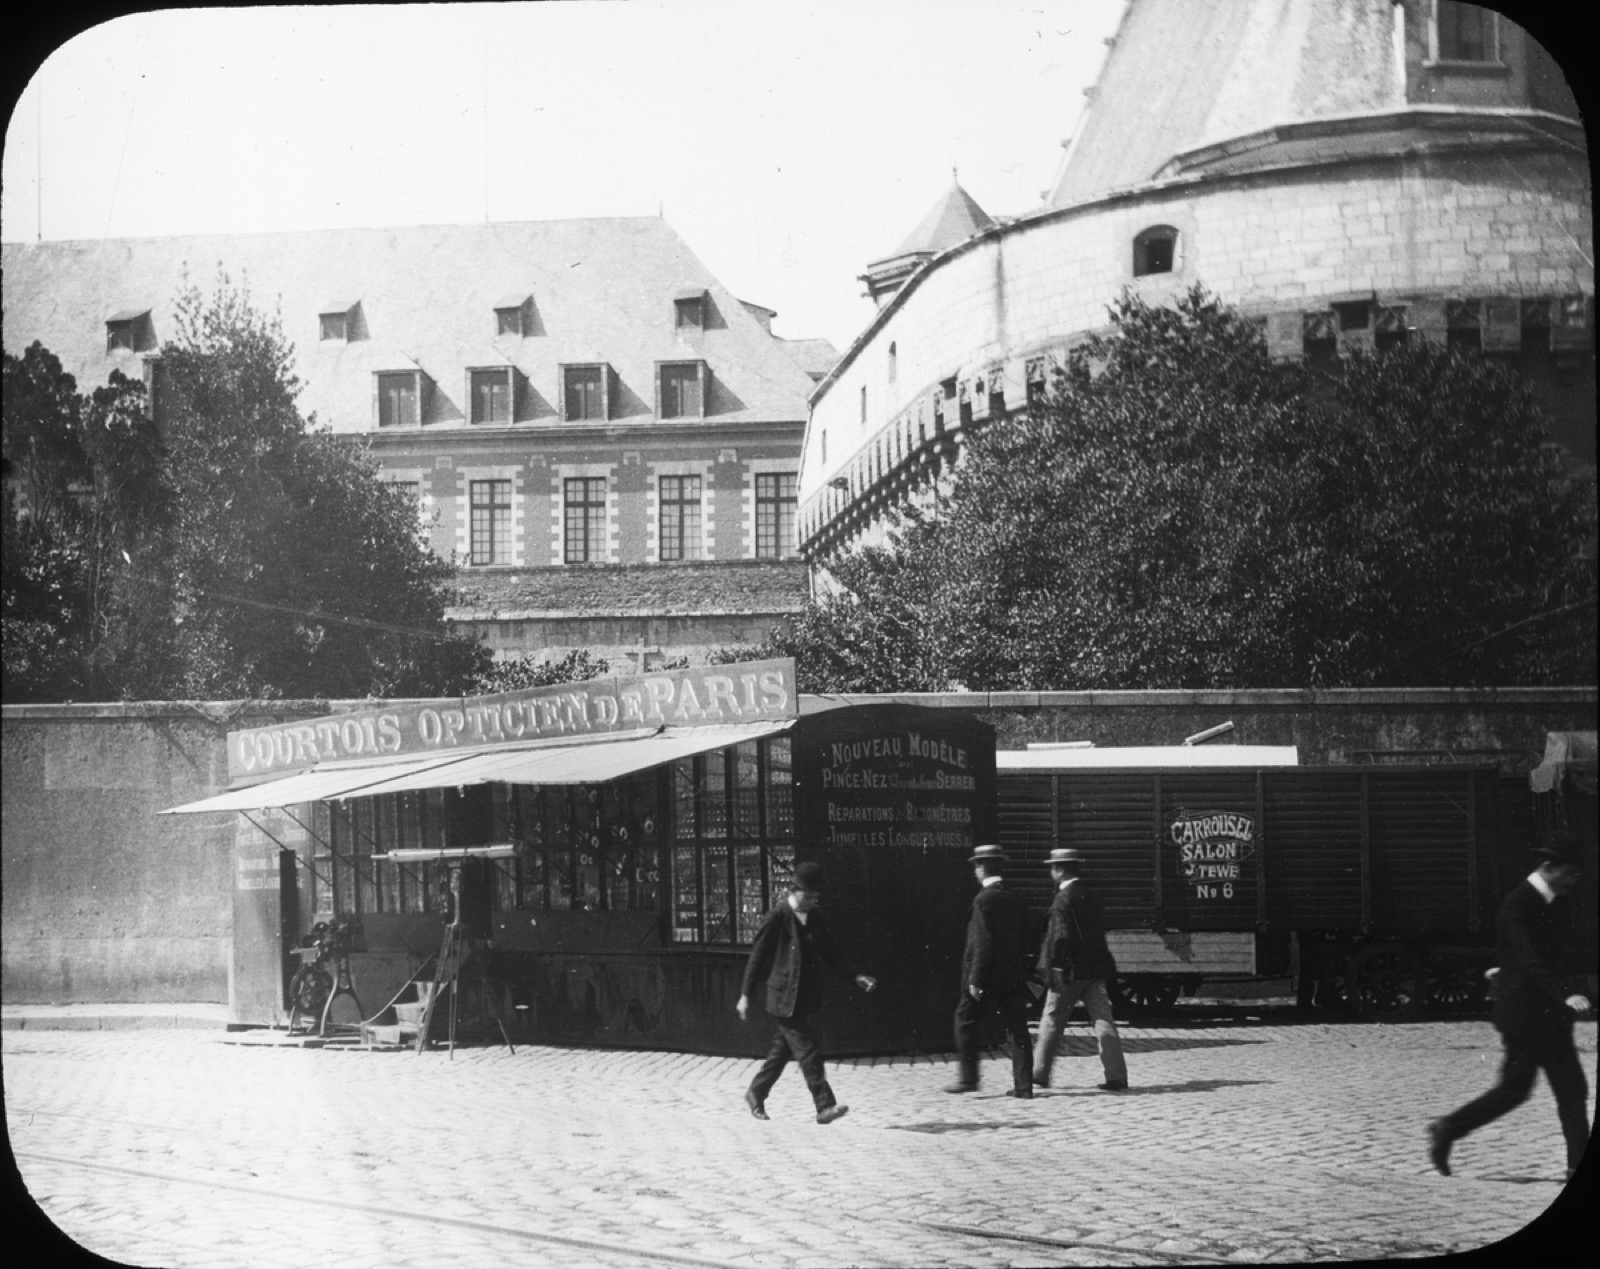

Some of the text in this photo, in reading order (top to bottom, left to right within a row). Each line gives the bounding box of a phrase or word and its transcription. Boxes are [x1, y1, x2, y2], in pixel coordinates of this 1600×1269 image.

[235, 670, 789, 770] COURTOIS OPTICIEN DE PARIS
[831, 737, 901, 768] NOUVEAU
[1171, 814, 1252, 844] CARROUSEL
[1182, 842, 1236, 862] SALON
[1198, 864, 1239, 878] TEWE
[1222, 882, 1234, 899] 6
